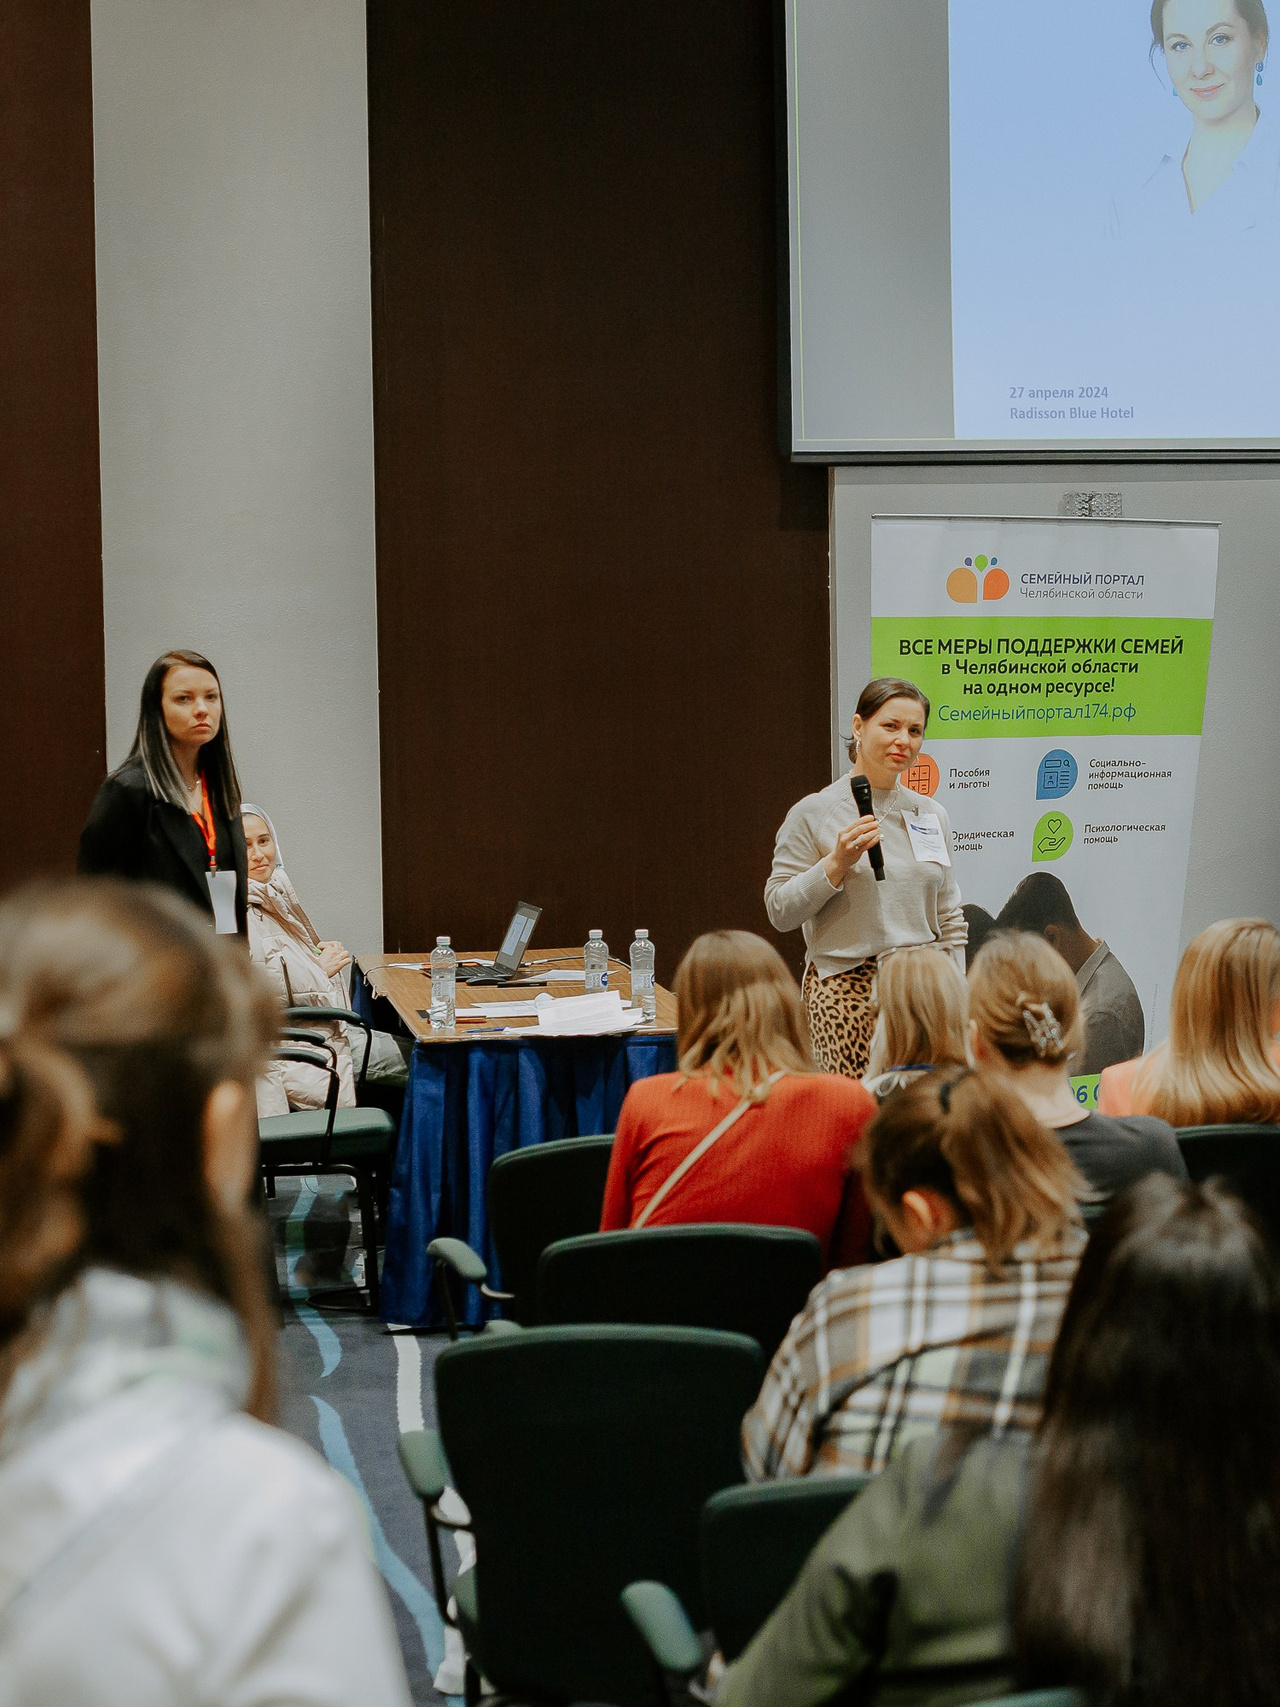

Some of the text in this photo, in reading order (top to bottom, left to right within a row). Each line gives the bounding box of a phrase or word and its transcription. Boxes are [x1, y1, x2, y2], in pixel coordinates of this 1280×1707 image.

[1009, 386, 1109, 401] 27 апреля 2024
[1010, 406, 1134, 420] Radisson Blue Hotel
[1020, 571, 1145, 586] СЕМЕЙНЫЙ ПОРТАЛ
[1019, 587, 1144, 600] Челябинской области
[899, 635, 1184, 657] ВСЕ МЕРЫ ПОДДЕРЖКИ СЕМЕЙ
[941, 658, 1139, 675] в Челябинской области
[963, 677, 1115, 698] на одном ресурсе!
[938, 702, 1137, 724] Семейныйпортал174.рф
[1089, 758, 1147, 769] Социально-
[949, 767, 990, 778] Пособия
[1088, 769, 1172, 781] информационная
[949, 780, 990, 790] и льготы
[1087, 782, 1124, 791] помощь
[1084, 823, 1166, 834] Психологическая
[1083, 835, 1119, 845] помощь
[953, 843, 983, 852] омощь
